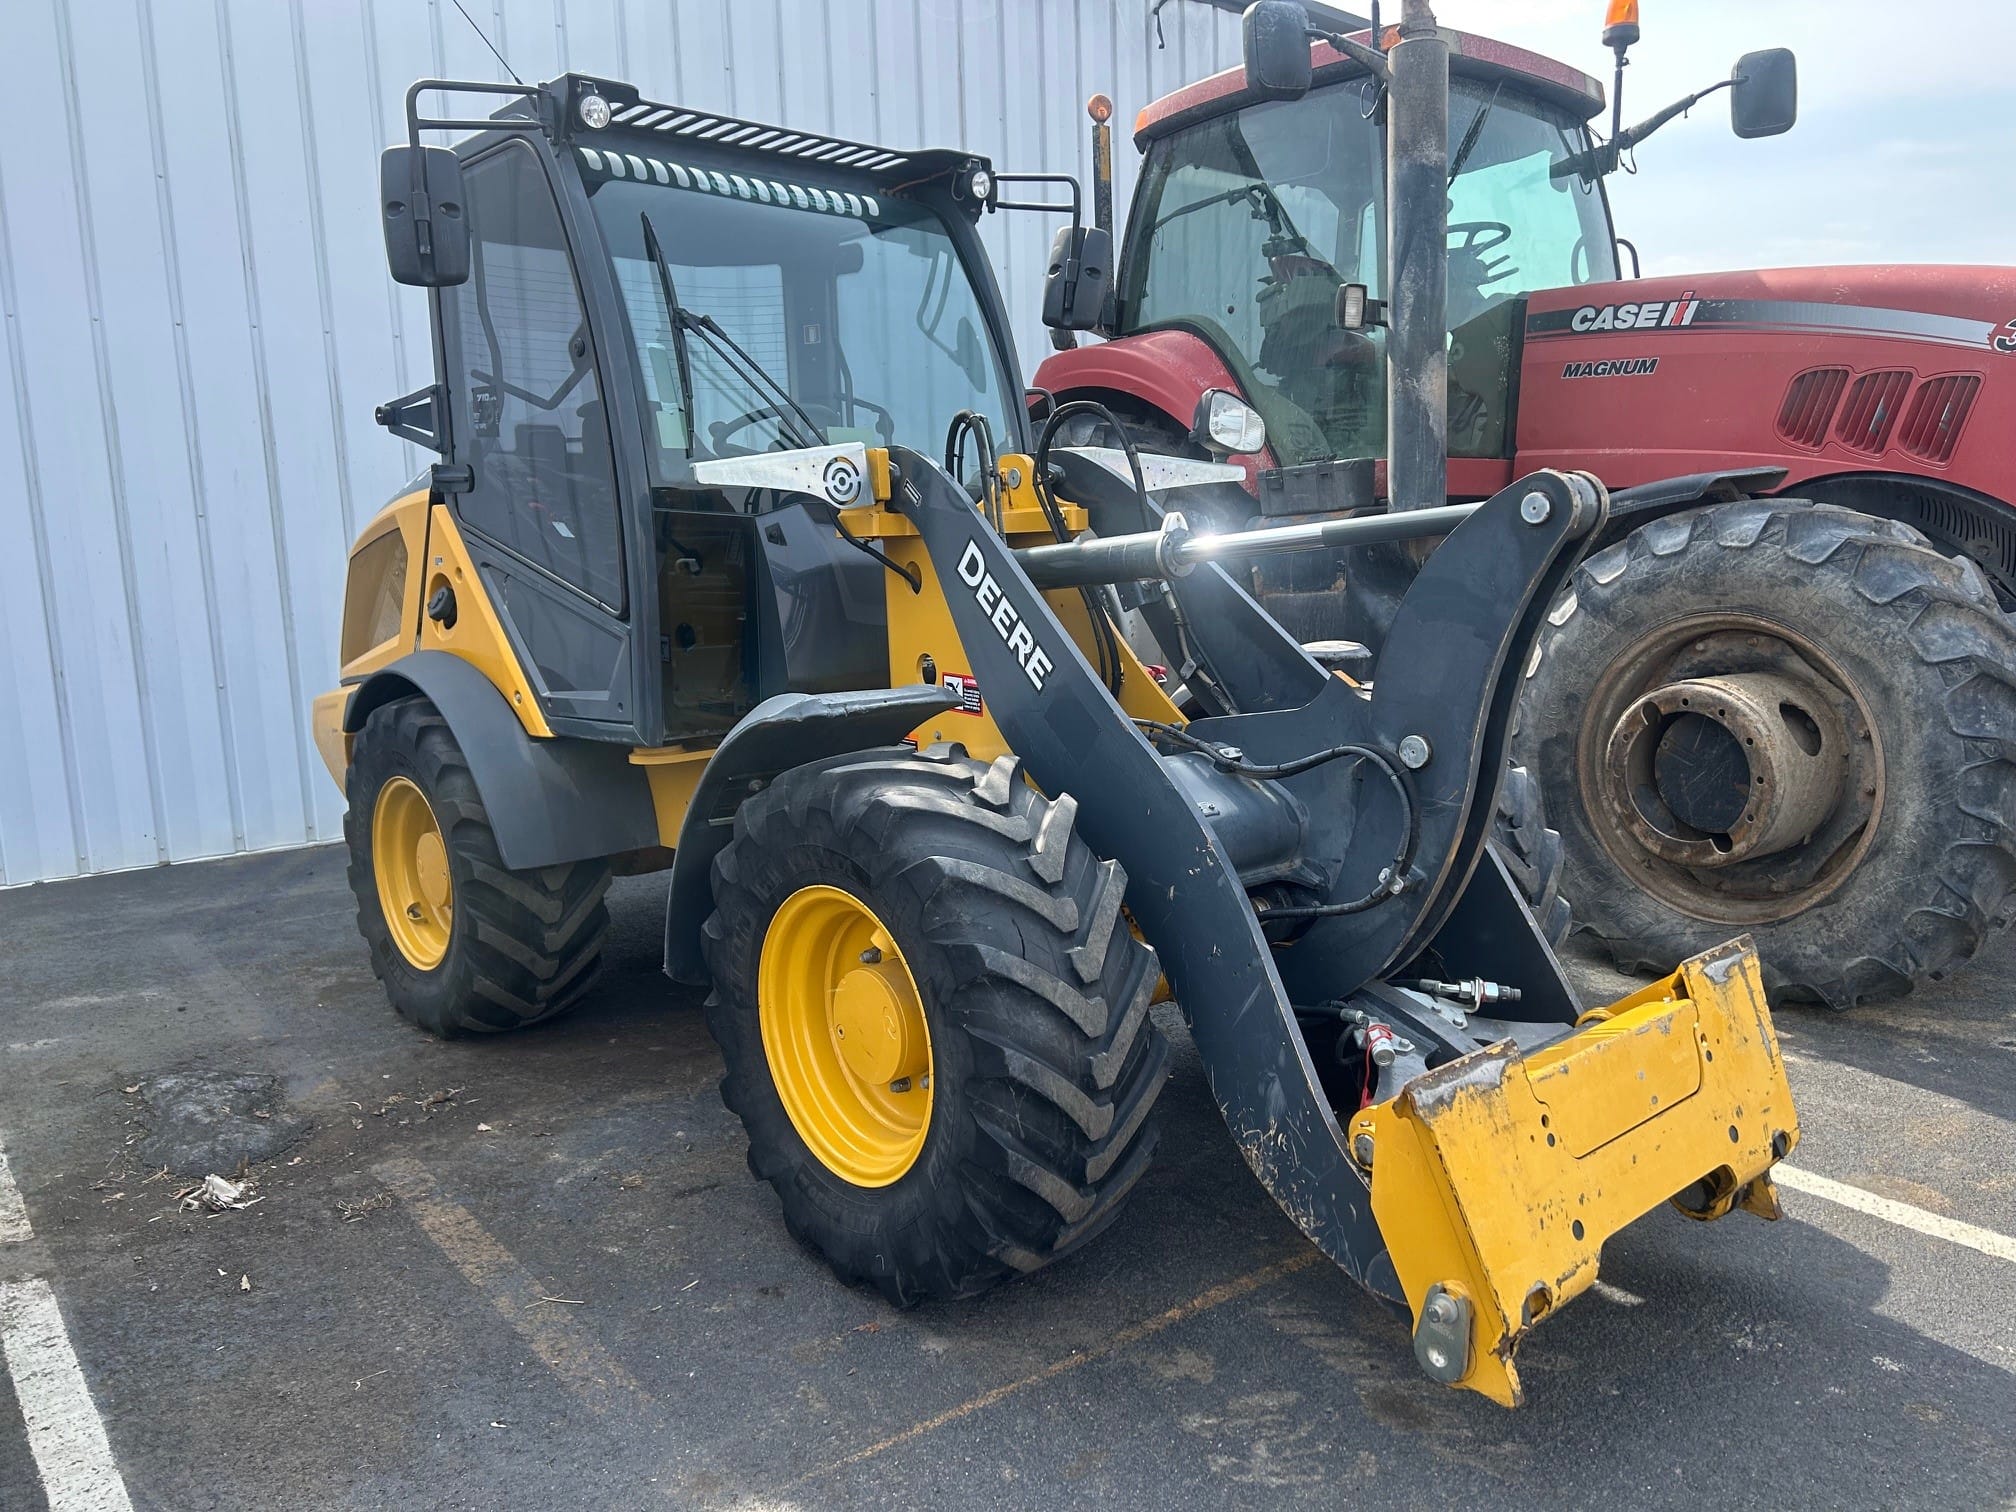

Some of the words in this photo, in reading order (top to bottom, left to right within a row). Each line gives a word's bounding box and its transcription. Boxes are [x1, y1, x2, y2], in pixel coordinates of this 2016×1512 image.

[1571, 301, 1664, 332] CASE
[1561, 358, 1660, 380] MAGNUM
[957, 540, 1053, 691] DEERE
